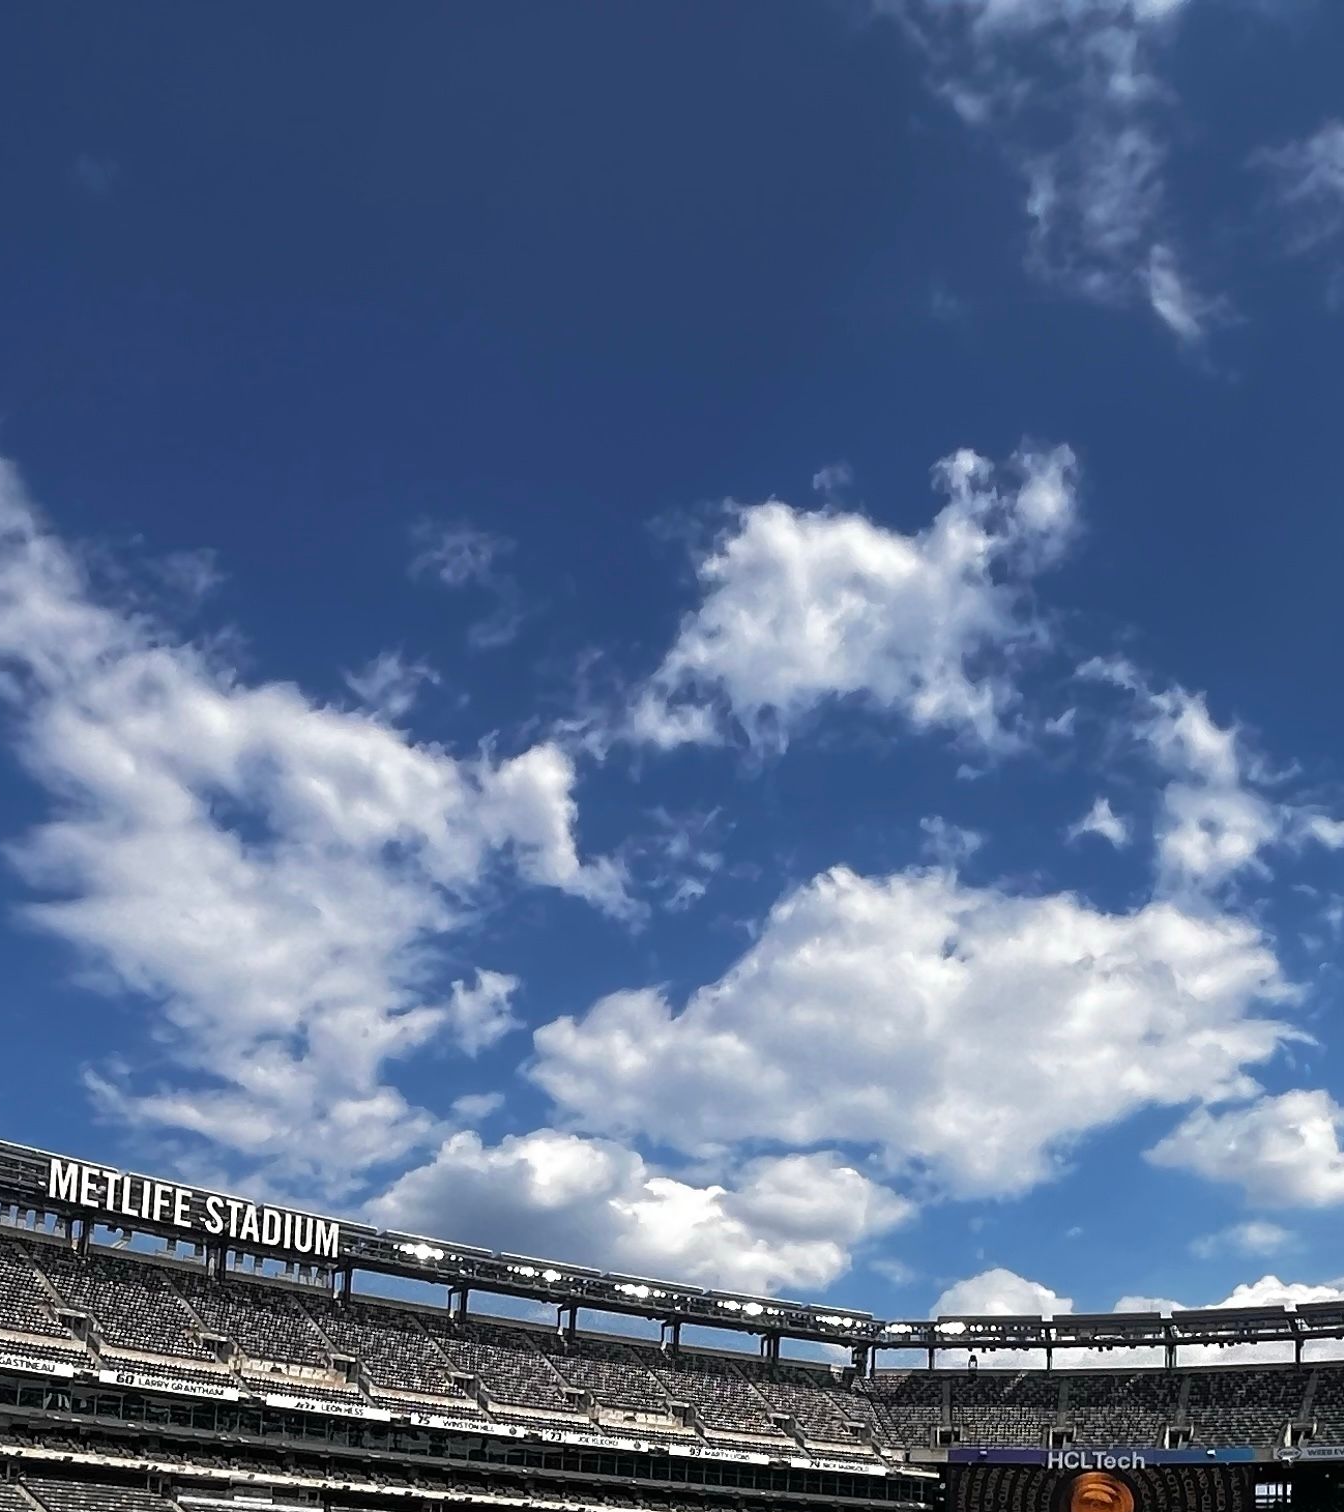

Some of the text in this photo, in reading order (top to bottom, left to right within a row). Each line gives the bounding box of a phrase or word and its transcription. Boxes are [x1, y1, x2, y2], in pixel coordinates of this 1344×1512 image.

[47, 1158, 341, 1259] METLIFE STADIUM
[115, 1373, 225, 1396] 60 LARRY GRANTHAM
[1047, 1450, 1146, 1470] HCLTech
